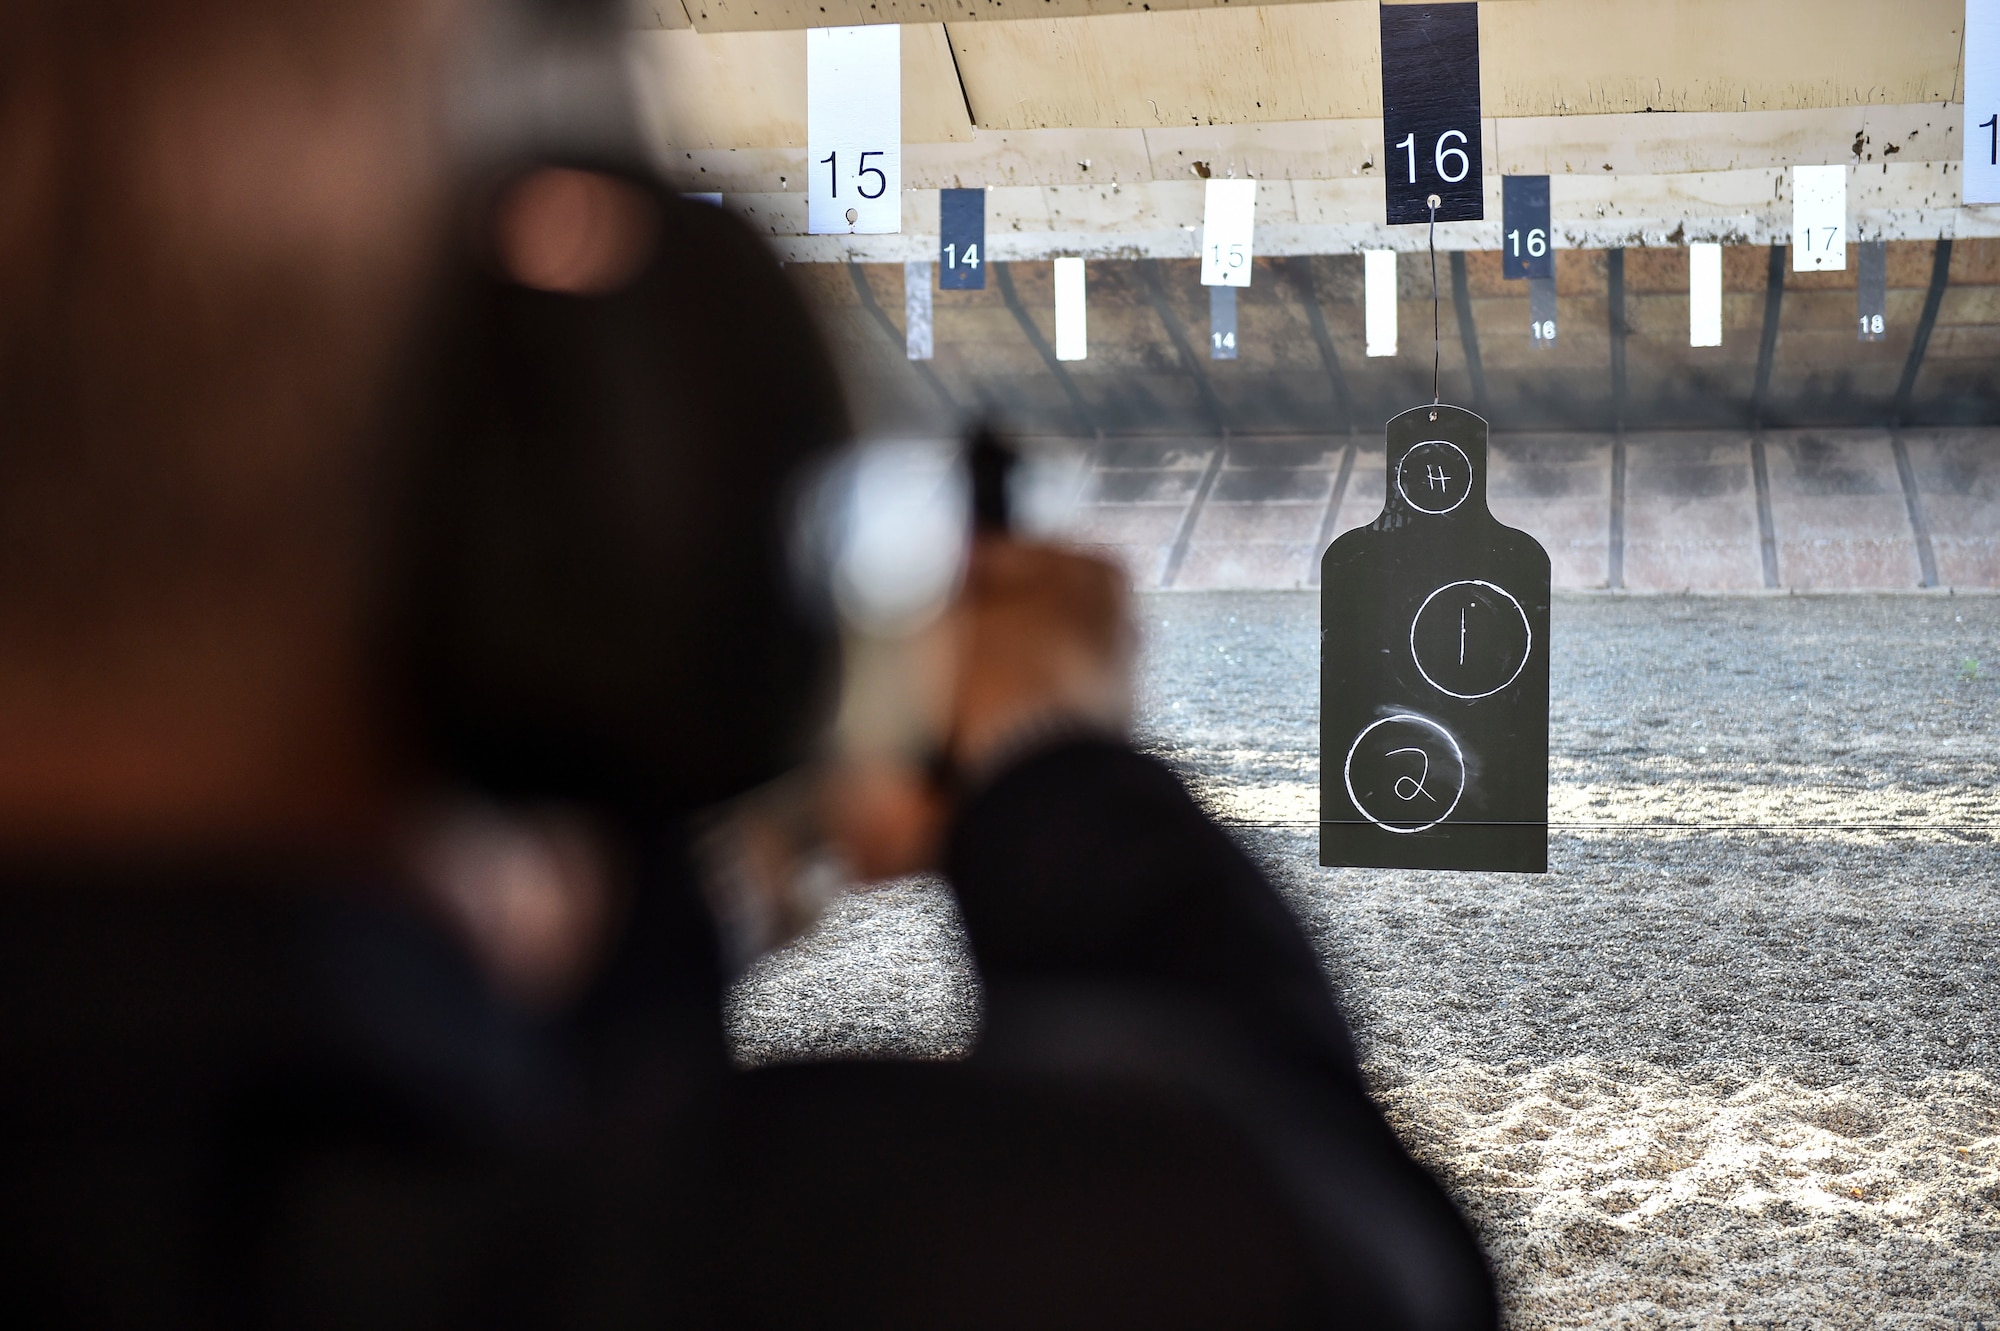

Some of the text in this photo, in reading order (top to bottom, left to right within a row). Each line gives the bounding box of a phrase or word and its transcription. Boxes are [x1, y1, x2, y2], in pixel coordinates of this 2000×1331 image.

[1395, 129, 1470, 184] 16
[820, 151, 887, 199] 15
[1507, 228, 1547, 258] 16
[1802, 226, 1838, 252] 17
[943, 243, 980, 270] 14
[1211, 243, 1244, 269] 15
[1531, 320, 1556, 340] 16
[1859, 314, 1885, 334] 18
[1212, 331, 1236, 350] 14
[1426, 464, 1452, 493] H
[1385, 747, 1437, 803] 2
